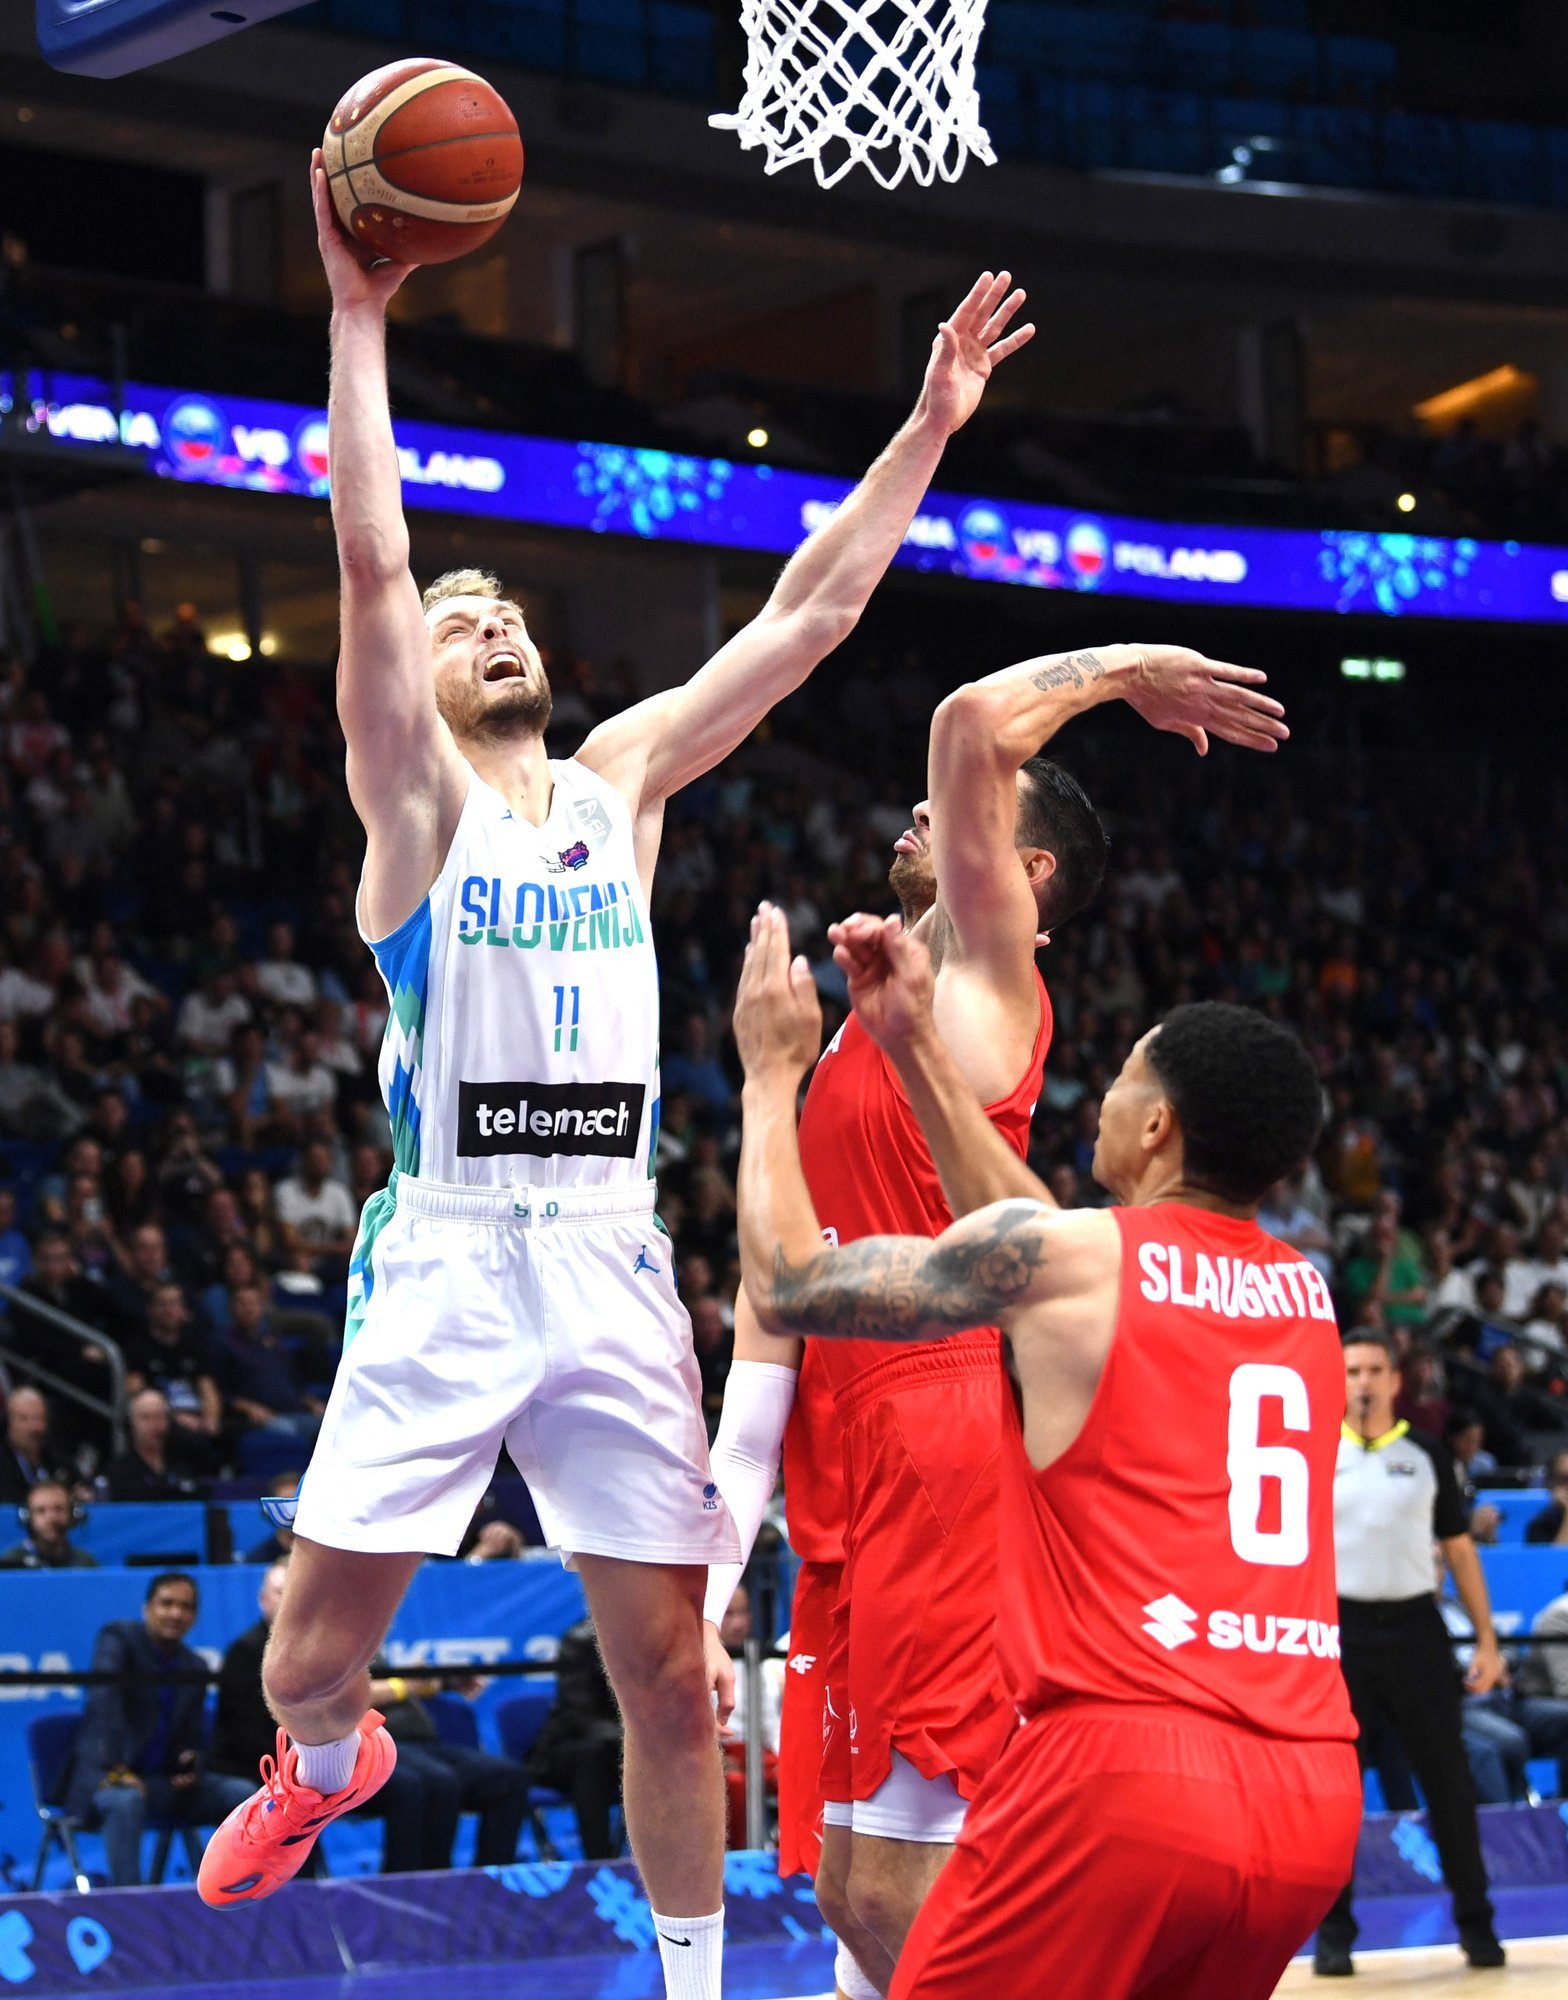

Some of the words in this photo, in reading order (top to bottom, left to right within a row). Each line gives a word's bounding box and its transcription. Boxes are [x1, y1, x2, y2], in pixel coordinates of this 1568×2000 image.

[1112, 540, 1248, 584] POLAND
[553, 985, 580, 1053] 11
[476, 1100, 630, 1137] telemach
[1226, 1362, 1311, 1567] 6
[702, 1500, 718, 1511] KZS
[1206, 1609, 1341, 1660] SUZUK
[789, 1653, 817, 1675] 4F
